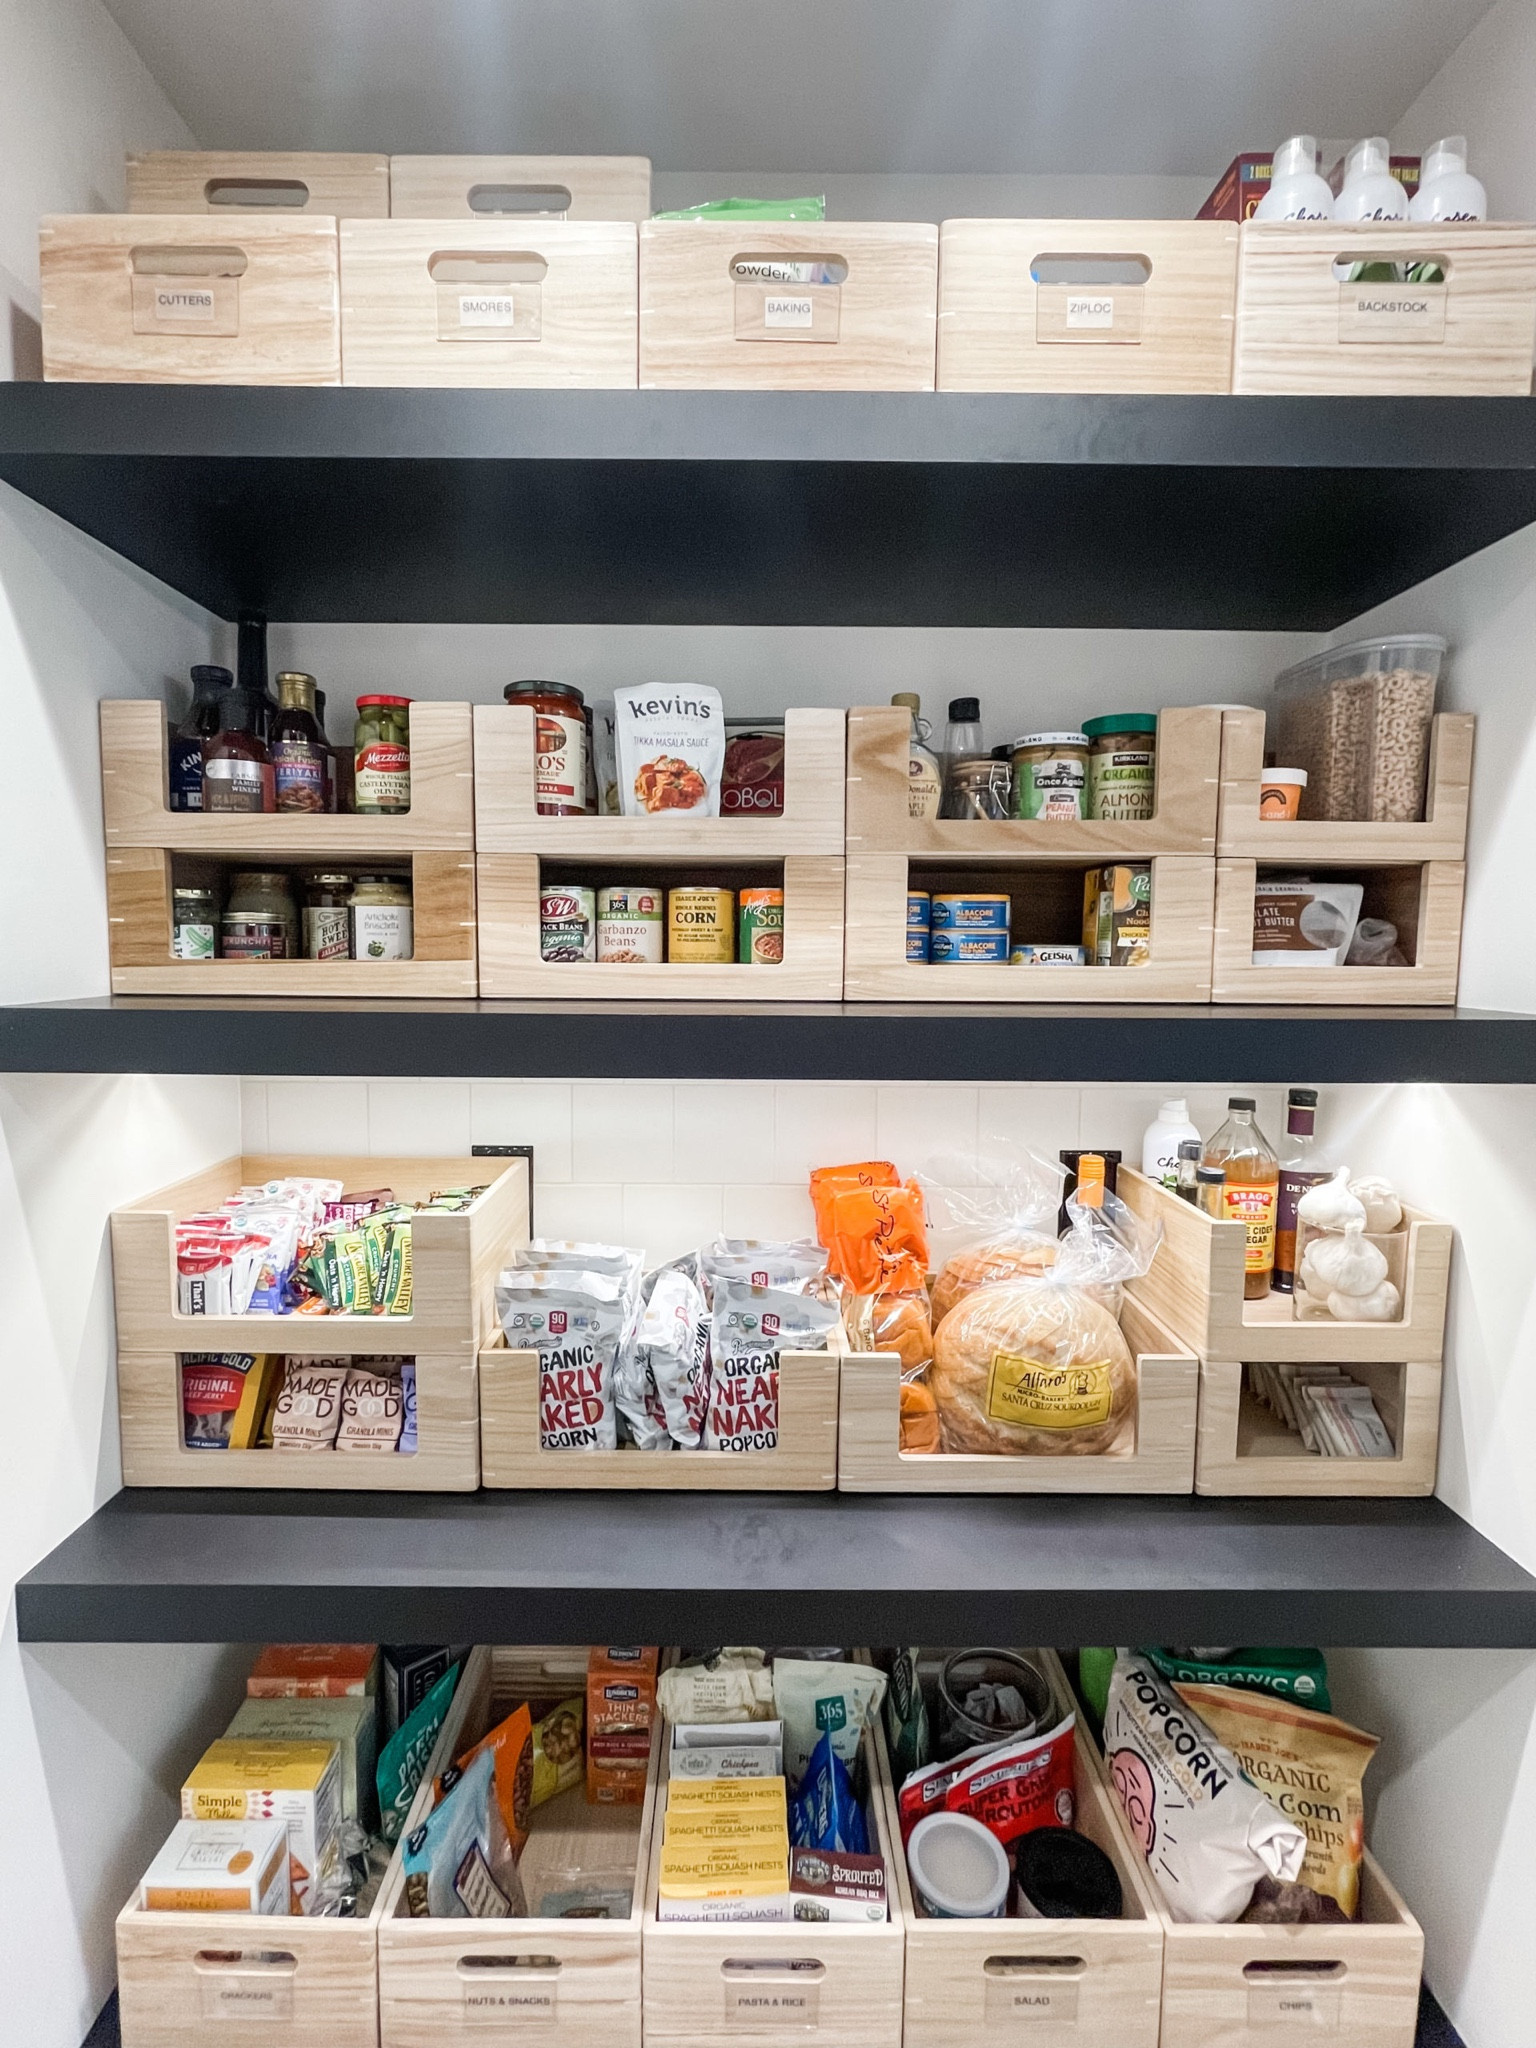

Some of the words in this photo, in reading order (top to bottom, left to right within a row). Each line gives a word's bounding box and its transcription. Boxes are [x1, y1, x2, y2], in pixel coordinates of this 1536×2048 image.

[733, 264, 787, 280] owder
[158, 294, 212, 306] CUTTERS
[462, 302, 511, 312] SMORES
[767, 303, 811, 313] BAKING
[1070, 303, 1111, 313] ZIPLOC
[1358, 302, 1428, 313] BACKSTOCK
[628, 695, 711, 719] kevin's
[656, 738, 684, 747] MASALA
[687, 738, 709, 747] SAUCE
[180, 751, 202, 772] KIN
[536, 755, 565, 771] O'S
[360, 781, 410, 789] CASTELVETRA
[1036, 778, 1060, 786] Once
[1062, 778, 1084, 787] Again
[1101, 793, 1153, 807] ALMON
[1046, 803, 1076, 812] PEANUT
[612, 901, 625, 910] 365
[744, 895, 772, 919] Amy's
[676, 912, 716, 924] CORN
[756, 911, 783, 926] SOU
[1265, 917, 1295, 926] BUTTER
[322, 921, 340, 937] HOT
[542, 923, 558, 931] ACK
[322, 929, 348, 946] SWEE
[604, 935, 636, 946] Beans
[1040, 952, 1073, 962] GEISHA
[1232, 1192, 1269, 1201] BRAGG
[1246, 1235, 1267, 1244] EGAR
[382, 1251, 390, 1268] Oats
[329, 1259, 337, 1275] Oats
[343, 1263, 352, 1294] CRUNCHY
[390, 1259, 399, 1292] CRUNCHY
[753, 1273, 766, 1285] 90
[331, 1284, 339, 1306] Honey
[375, 1277, 385, 1302] Honey
[396, 1275, 411, 1312] VALLEY
[551, 1313, 565, 1325] 90
[764, 1316, 778, 1328] 90
[863, 1329, 872, 1351] BRIO
[183, 1353, 218, 1366] ACIFIC
[221, 1353, 252, 1370] GOLD
[540, 1345, 594, 1372] GANIC
[185, 1378, 236, 1393] RIGINAL
[282, 1376, 339, 1397] MADE
[341, 1379, 400, 1397] MADE
[541, 1363, 603, 1402] ARLY
[1002, 1392, 1029, 1408] SANTA
[1030, 1400, 1053, 1411] CRUZ
[713, 1404, 779, 1437] NAK
[273, 1425, 304, 1435] GRANOLA
[346, 1426, 375, 1435] GRANOLA
[719, 1432, 779, 1451] POPCO
[1179, 1669, 1288, 1692] ORGANIC
[608, 1702, 635, 1713] THIN
[819, 1702, 843, 1721] 365
[593, 1711, 649, 1724] STACKERS
[1126, 1671, 1228, 1800] POPCORN
[1240, 1741, 1271, 1753] TRADER
[197, 1795, 242, 1808] Simple
[671, 1792, 717, 1800] SPAGHETTI
[1279, 1793, 1342, 1823] Corn
[669, 1826, 717, 1836] SPAGHETTI
[718, 1825, 755, 1833] SQUASH
[756, 1824, 784, 1832] NESTS
[664, 1863, 713, 1873] SPAGHETTI
[715, 1862, 753, 1871] SQUASH
[754, 1861, 784, 1869] NESTS
[832, 1864, 884, 1886] SPROUTED
[702, 1902, 746, 1911] ORGANIC
[664, 1912, 730, 1921] SPAGHETTI
[732, 1909, 783, 1920] SQUASH
[220, 1991, 273, 2000] CRACKERS
[467, 1997, 496, 2005] NUTS
[498, 1997, 505, 2005] &
[508, 1997, 551, 2005] SNACKS
[1014, 1996, 1050, 2006] SALAD
[738, 1998, 769, 2006] PASTA
[782, 1998, 806, 2007] RICE
[1279, 2001, 1312, 2011] CHIPS
